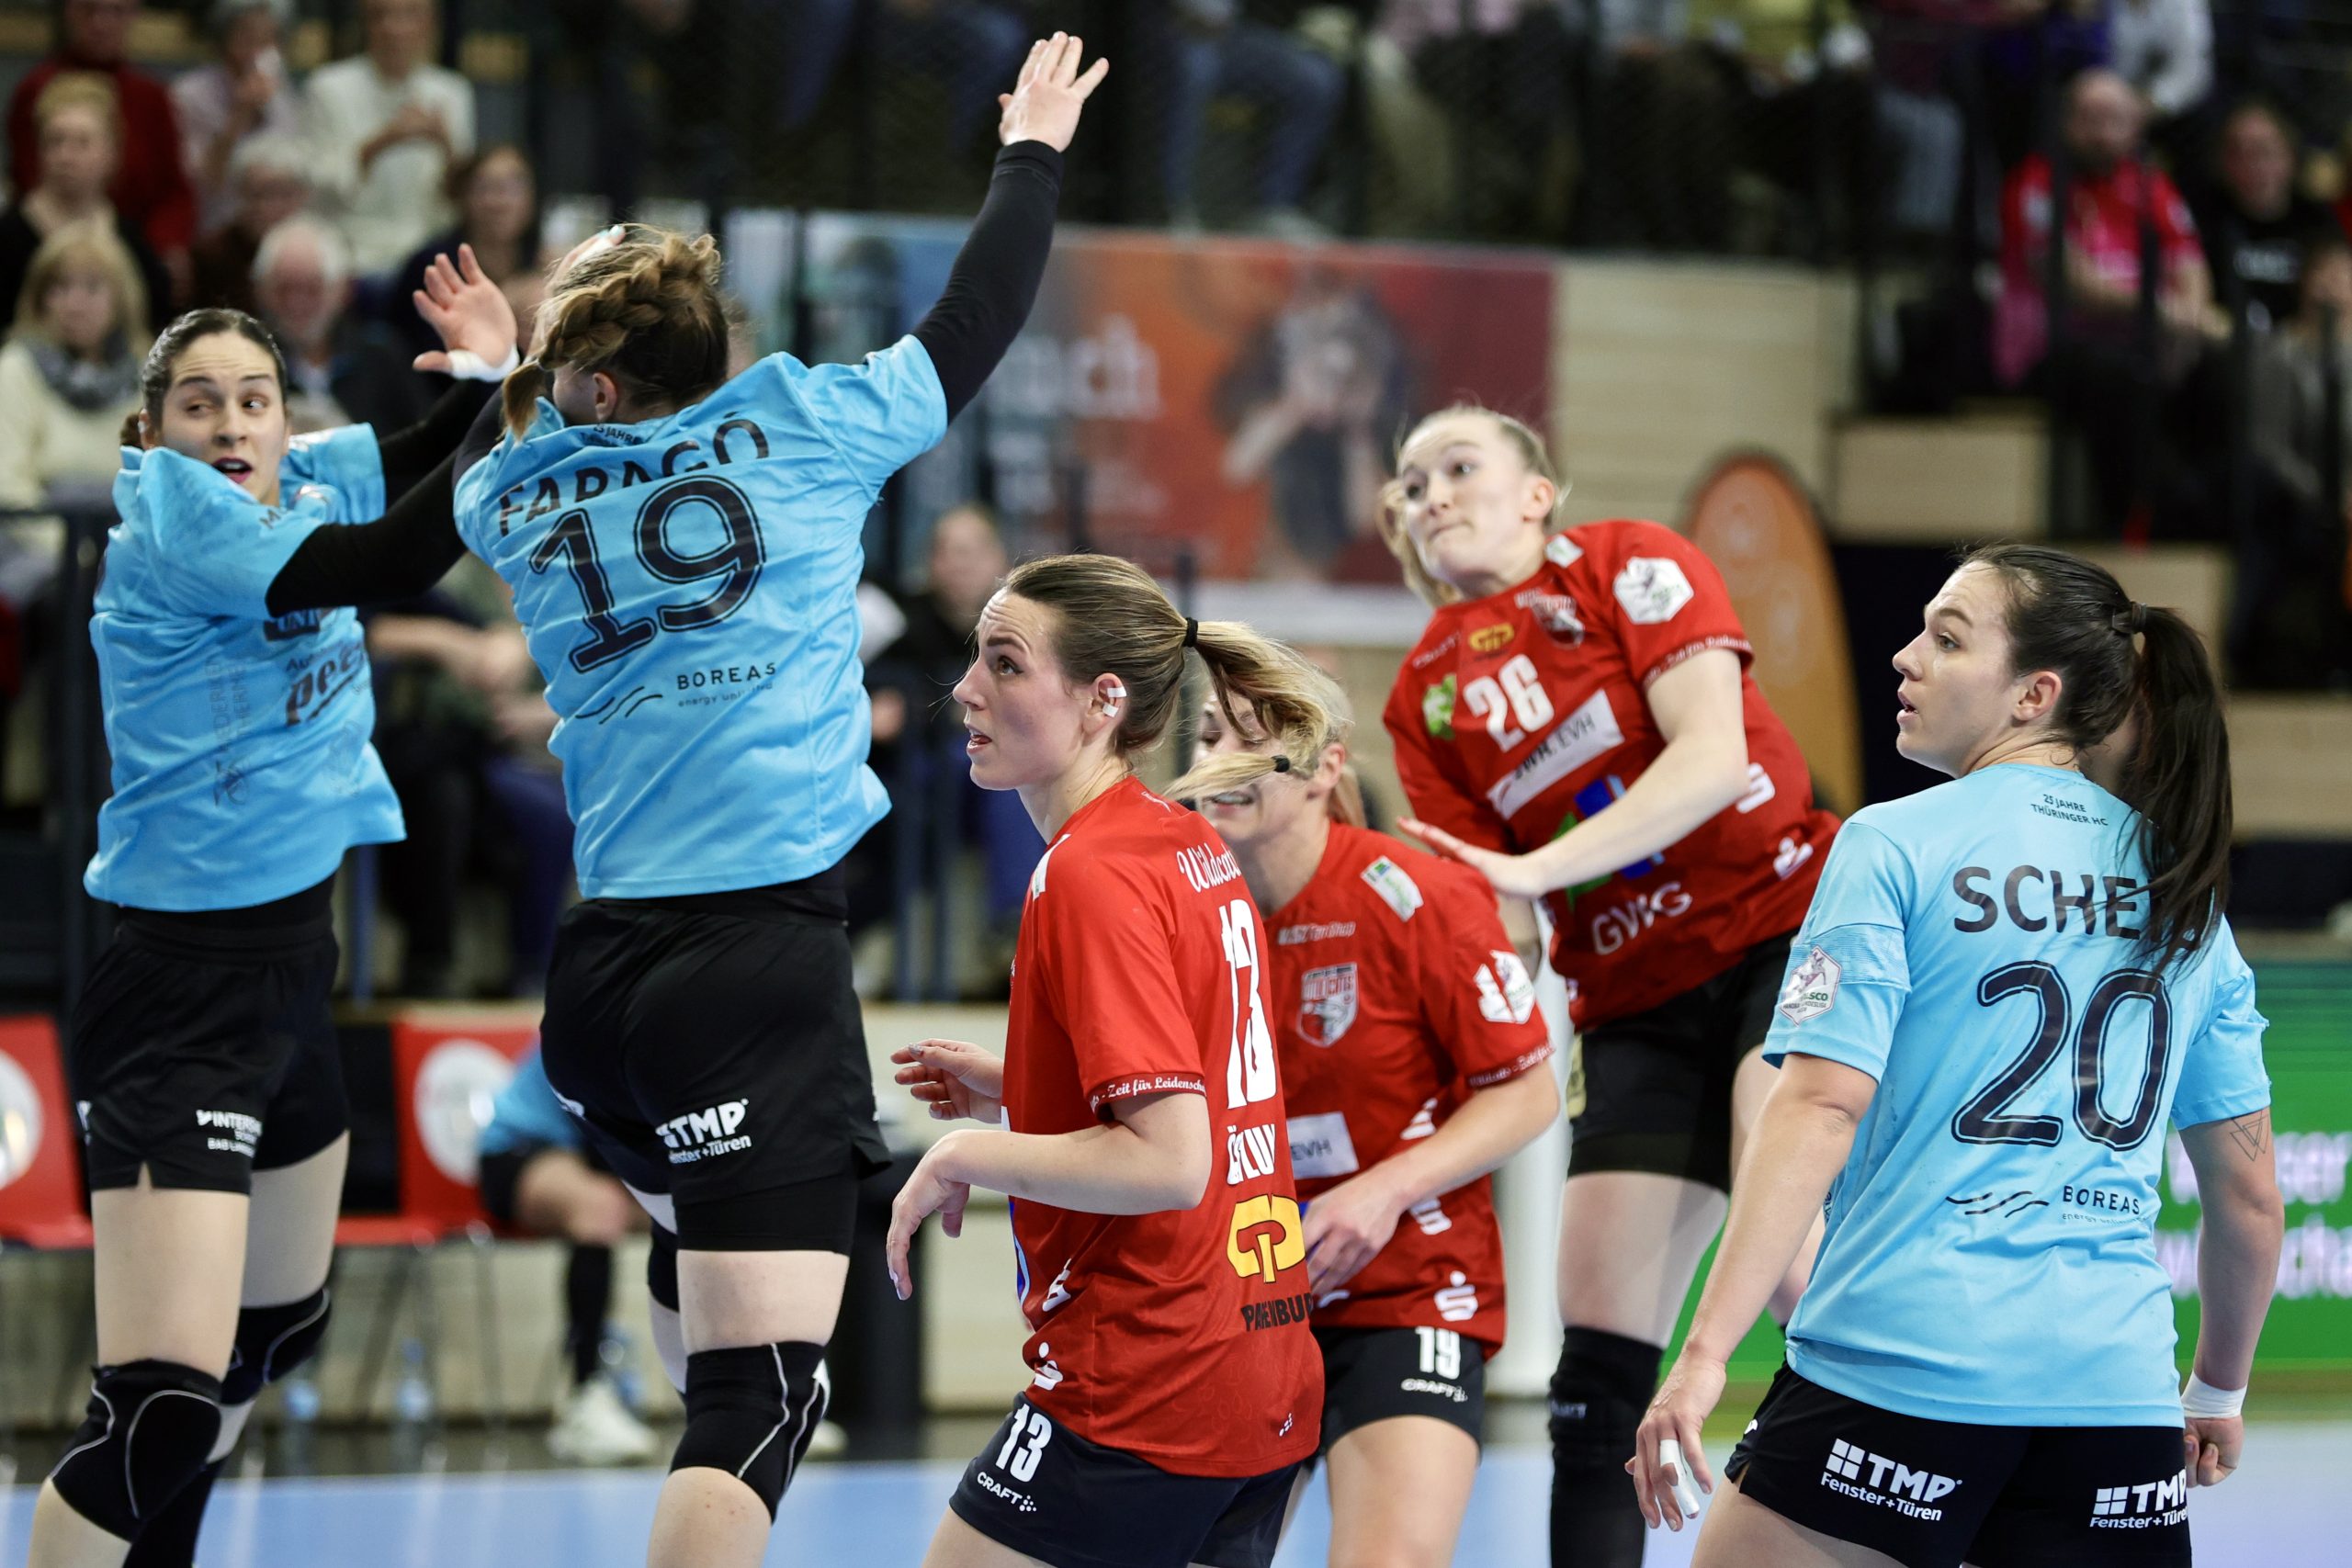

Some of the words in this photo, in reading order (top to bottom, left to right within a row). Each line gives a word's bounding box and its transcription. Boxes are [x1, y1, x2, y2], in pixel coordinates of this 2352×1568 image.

[528, 474, 766, 674] 19
[676, 662, 776, 691] BOREAS
[1463, 653, 1555, 753] 26
[2030, 803, 2092, 825] THÜRINGER
[2091, 817, 2109, 827] HC
[2042, 794, 2054, 806] 25
[2055, 797, 2087, 813] JAHRE
[1218, 898, 1278, 1110] 13
[1951, 960, 2173, 1152] 20
[1107, 1084, 1131, 1099] Zeit
[1133, 1078, 1152, 1097] für
[669, 1100, 747, 1146] TMP
[2062, 1185, 2141, 1216] BOREAS
[1414, 1325, 1462, 1381] 19
[995, 1403, 1053, 1483] 13
[977, 1472, 1023, 1505] CRAFT
[1867, 1452, 1961, 1504] TMP
[2132, 1467, 2187, 1514] TMP
